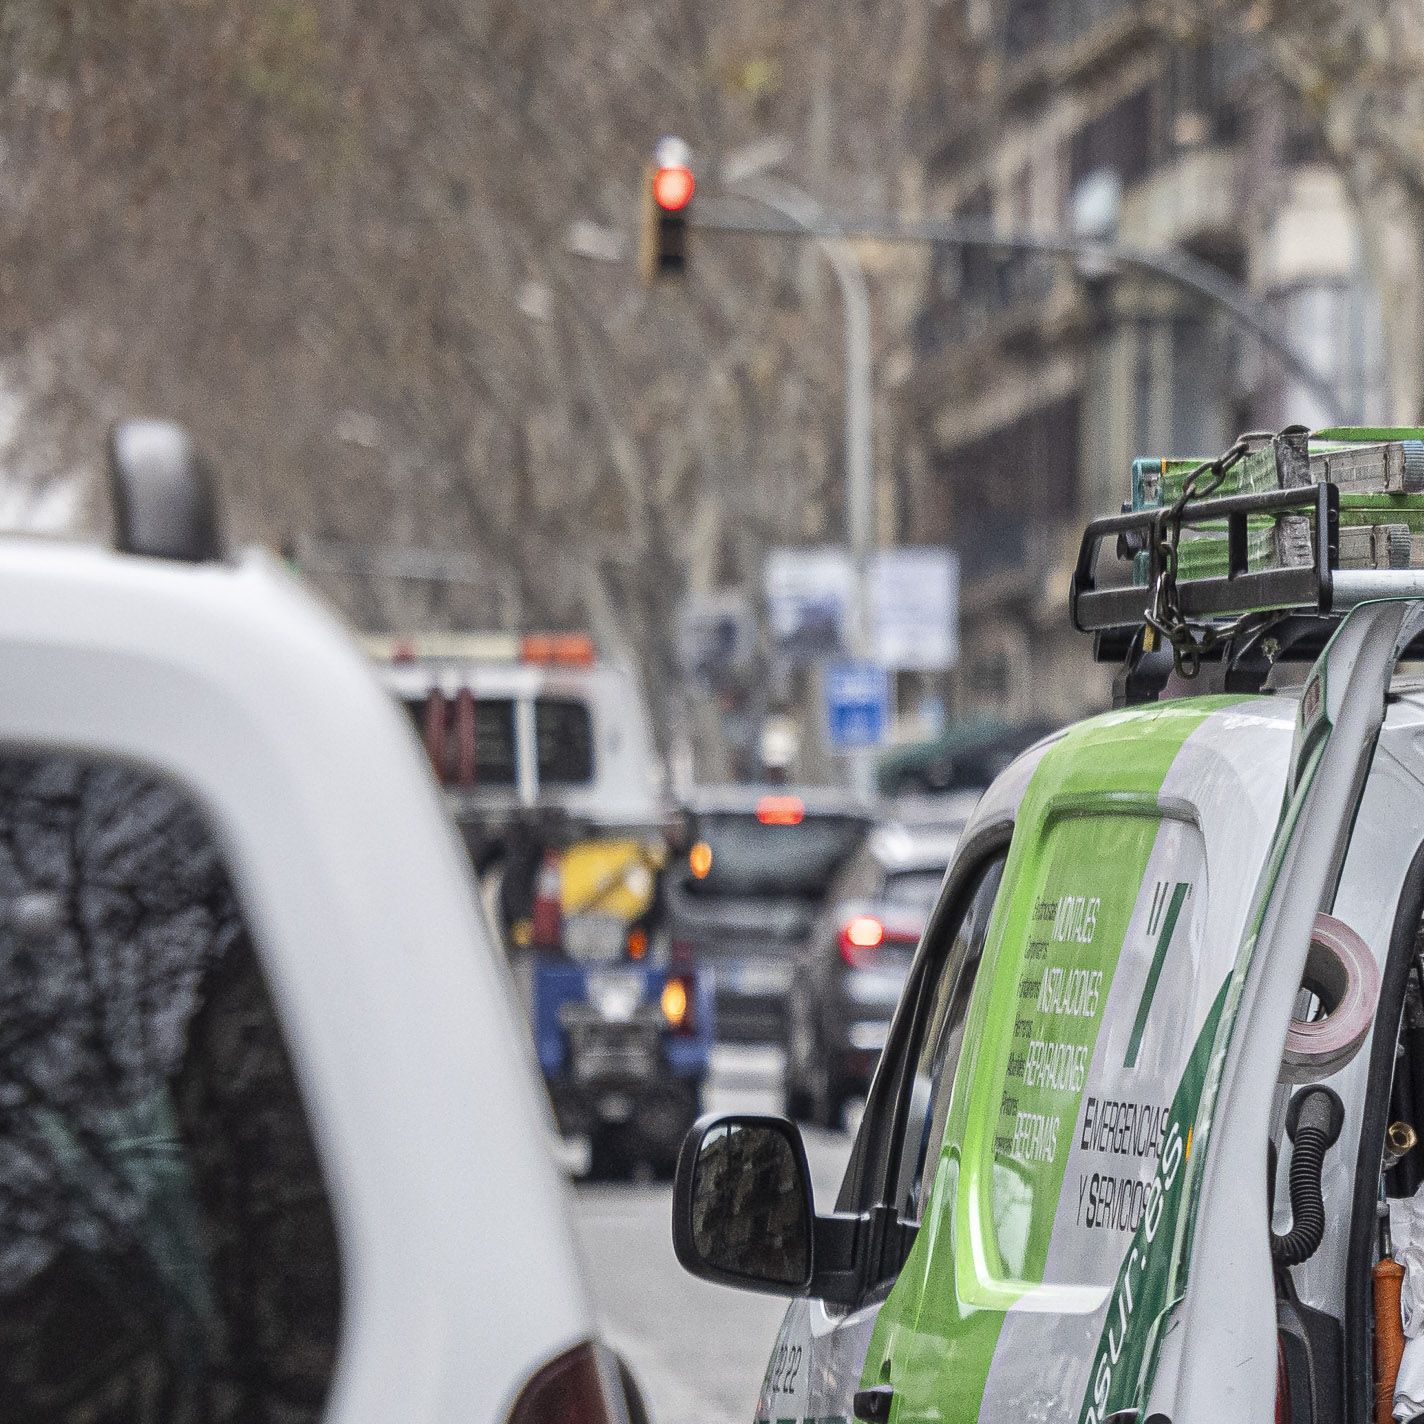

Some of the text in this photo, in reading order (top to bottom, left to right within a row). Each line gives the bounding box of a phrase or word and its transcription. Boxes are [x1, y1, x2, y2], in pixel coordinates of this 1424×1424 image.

[1023, 1040, 1089, 1093] REPARACIONES
[1012, 1112, 1060, 1163] REFORMAS
[1080, 1097, 1169, 1158] EMERGENCIAS
[1077, 1174, 1088, 1226] Y
